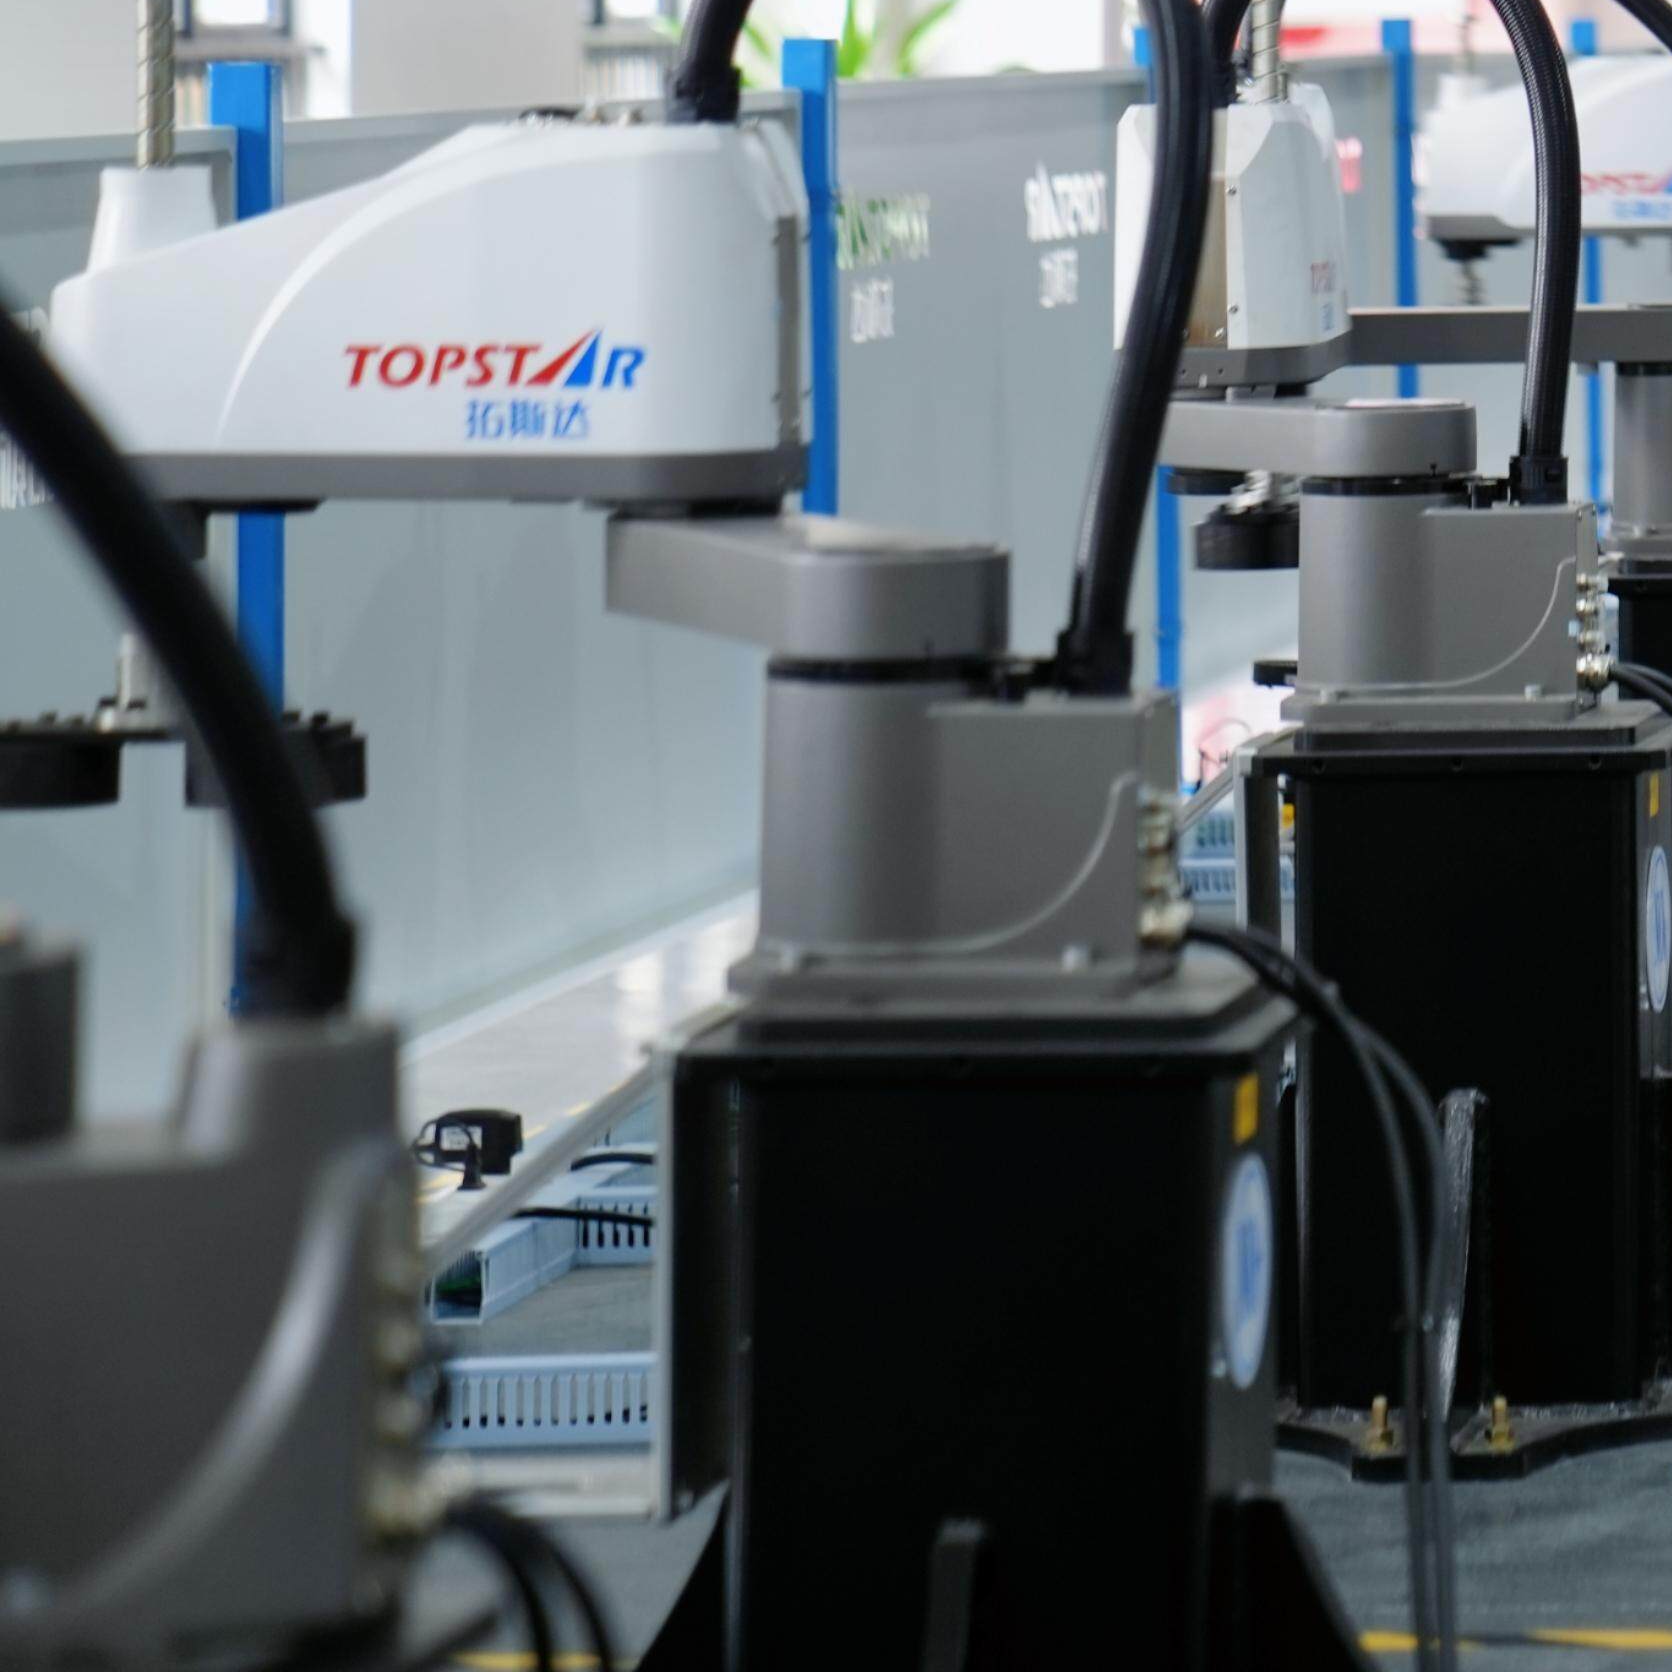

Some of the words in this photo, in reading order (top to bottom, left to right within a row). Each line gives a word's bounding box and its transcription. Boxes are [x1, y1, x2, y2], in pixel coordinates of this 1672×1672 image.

[345, 327, 646, 390] TOPSTAR
[466, 397, 590, 440] 拓斯达
